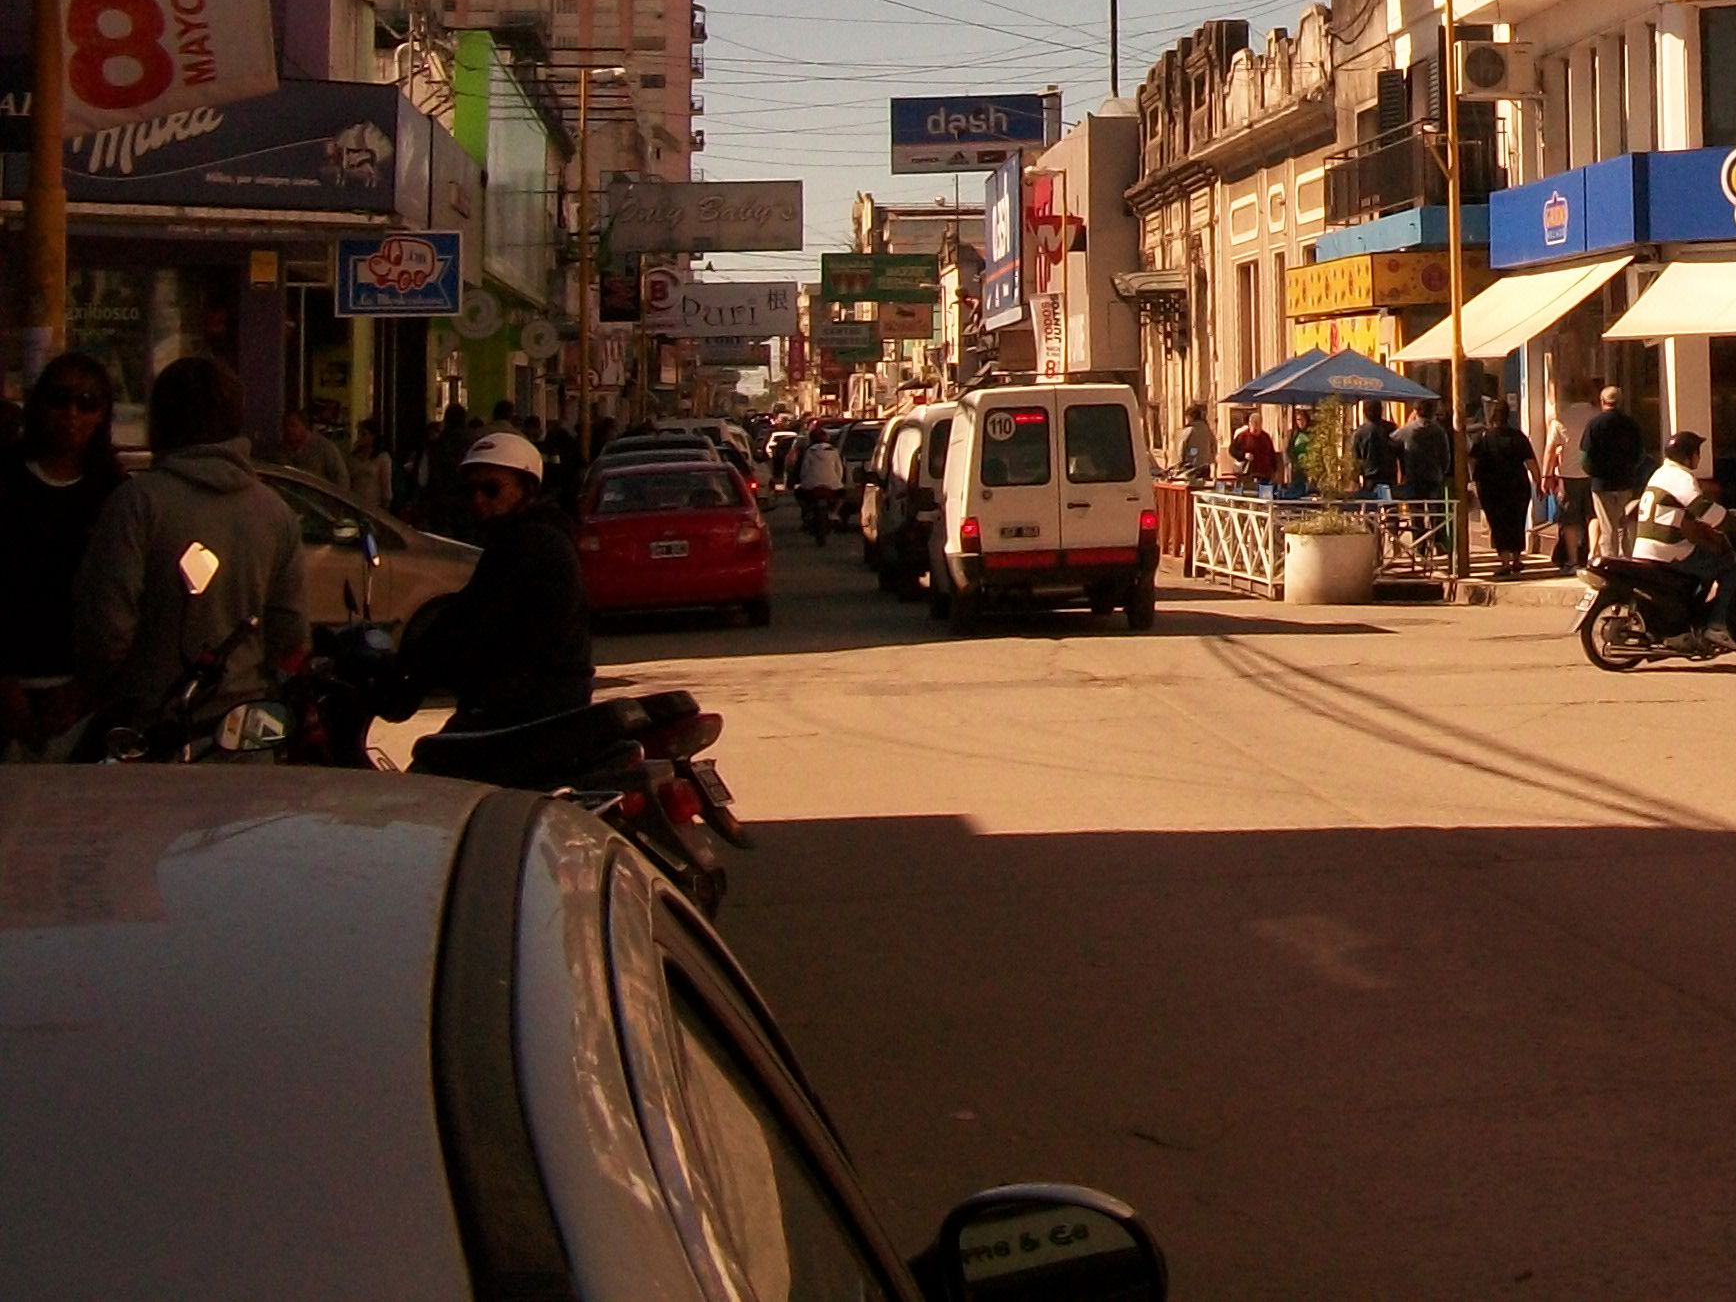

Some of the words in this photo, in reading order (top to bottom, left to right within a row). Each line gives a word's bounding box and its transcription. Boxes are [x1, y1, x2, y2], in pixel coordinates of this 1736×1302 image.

[927, 107, 1008, 136] dash
[1041, 302, 1054, 344] TODOS
[1050, 293, 1062, 344] JUNTOS
[1045, 359, 1056, 379] 8
[989, 417, 1013, 435] 110
